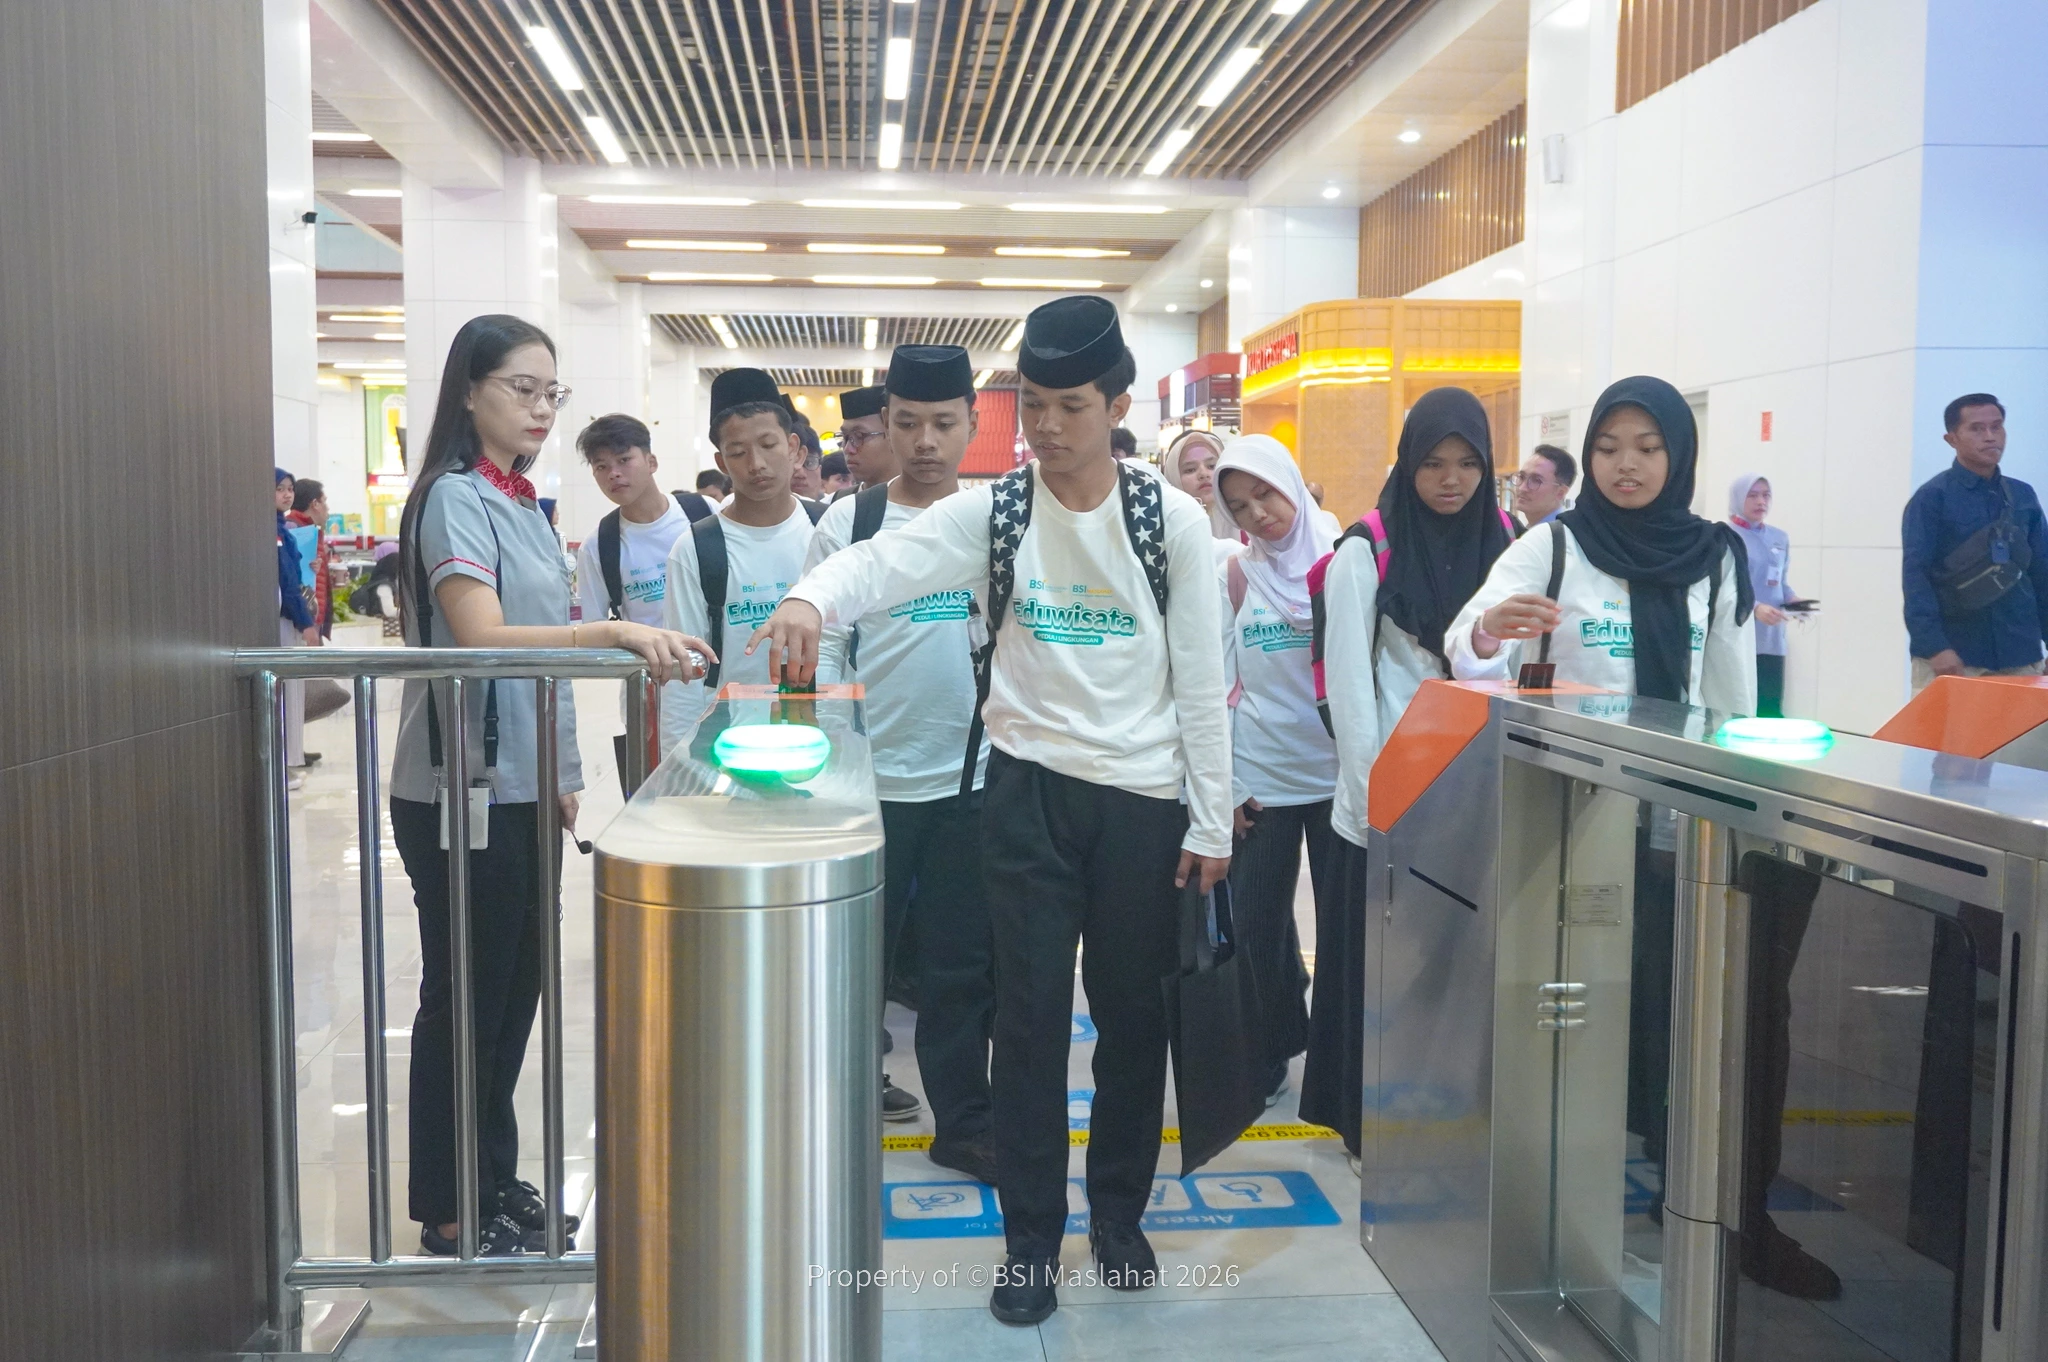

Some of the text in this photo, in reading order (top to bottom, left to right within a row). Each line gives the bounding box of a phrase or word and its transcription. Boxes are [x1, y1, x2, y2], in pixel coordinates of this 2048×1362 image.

[742, 584, 756, 593] BSI
[1072, 585, 1087, 593] BSI
[1604, 600, 1620, 610] BSI
